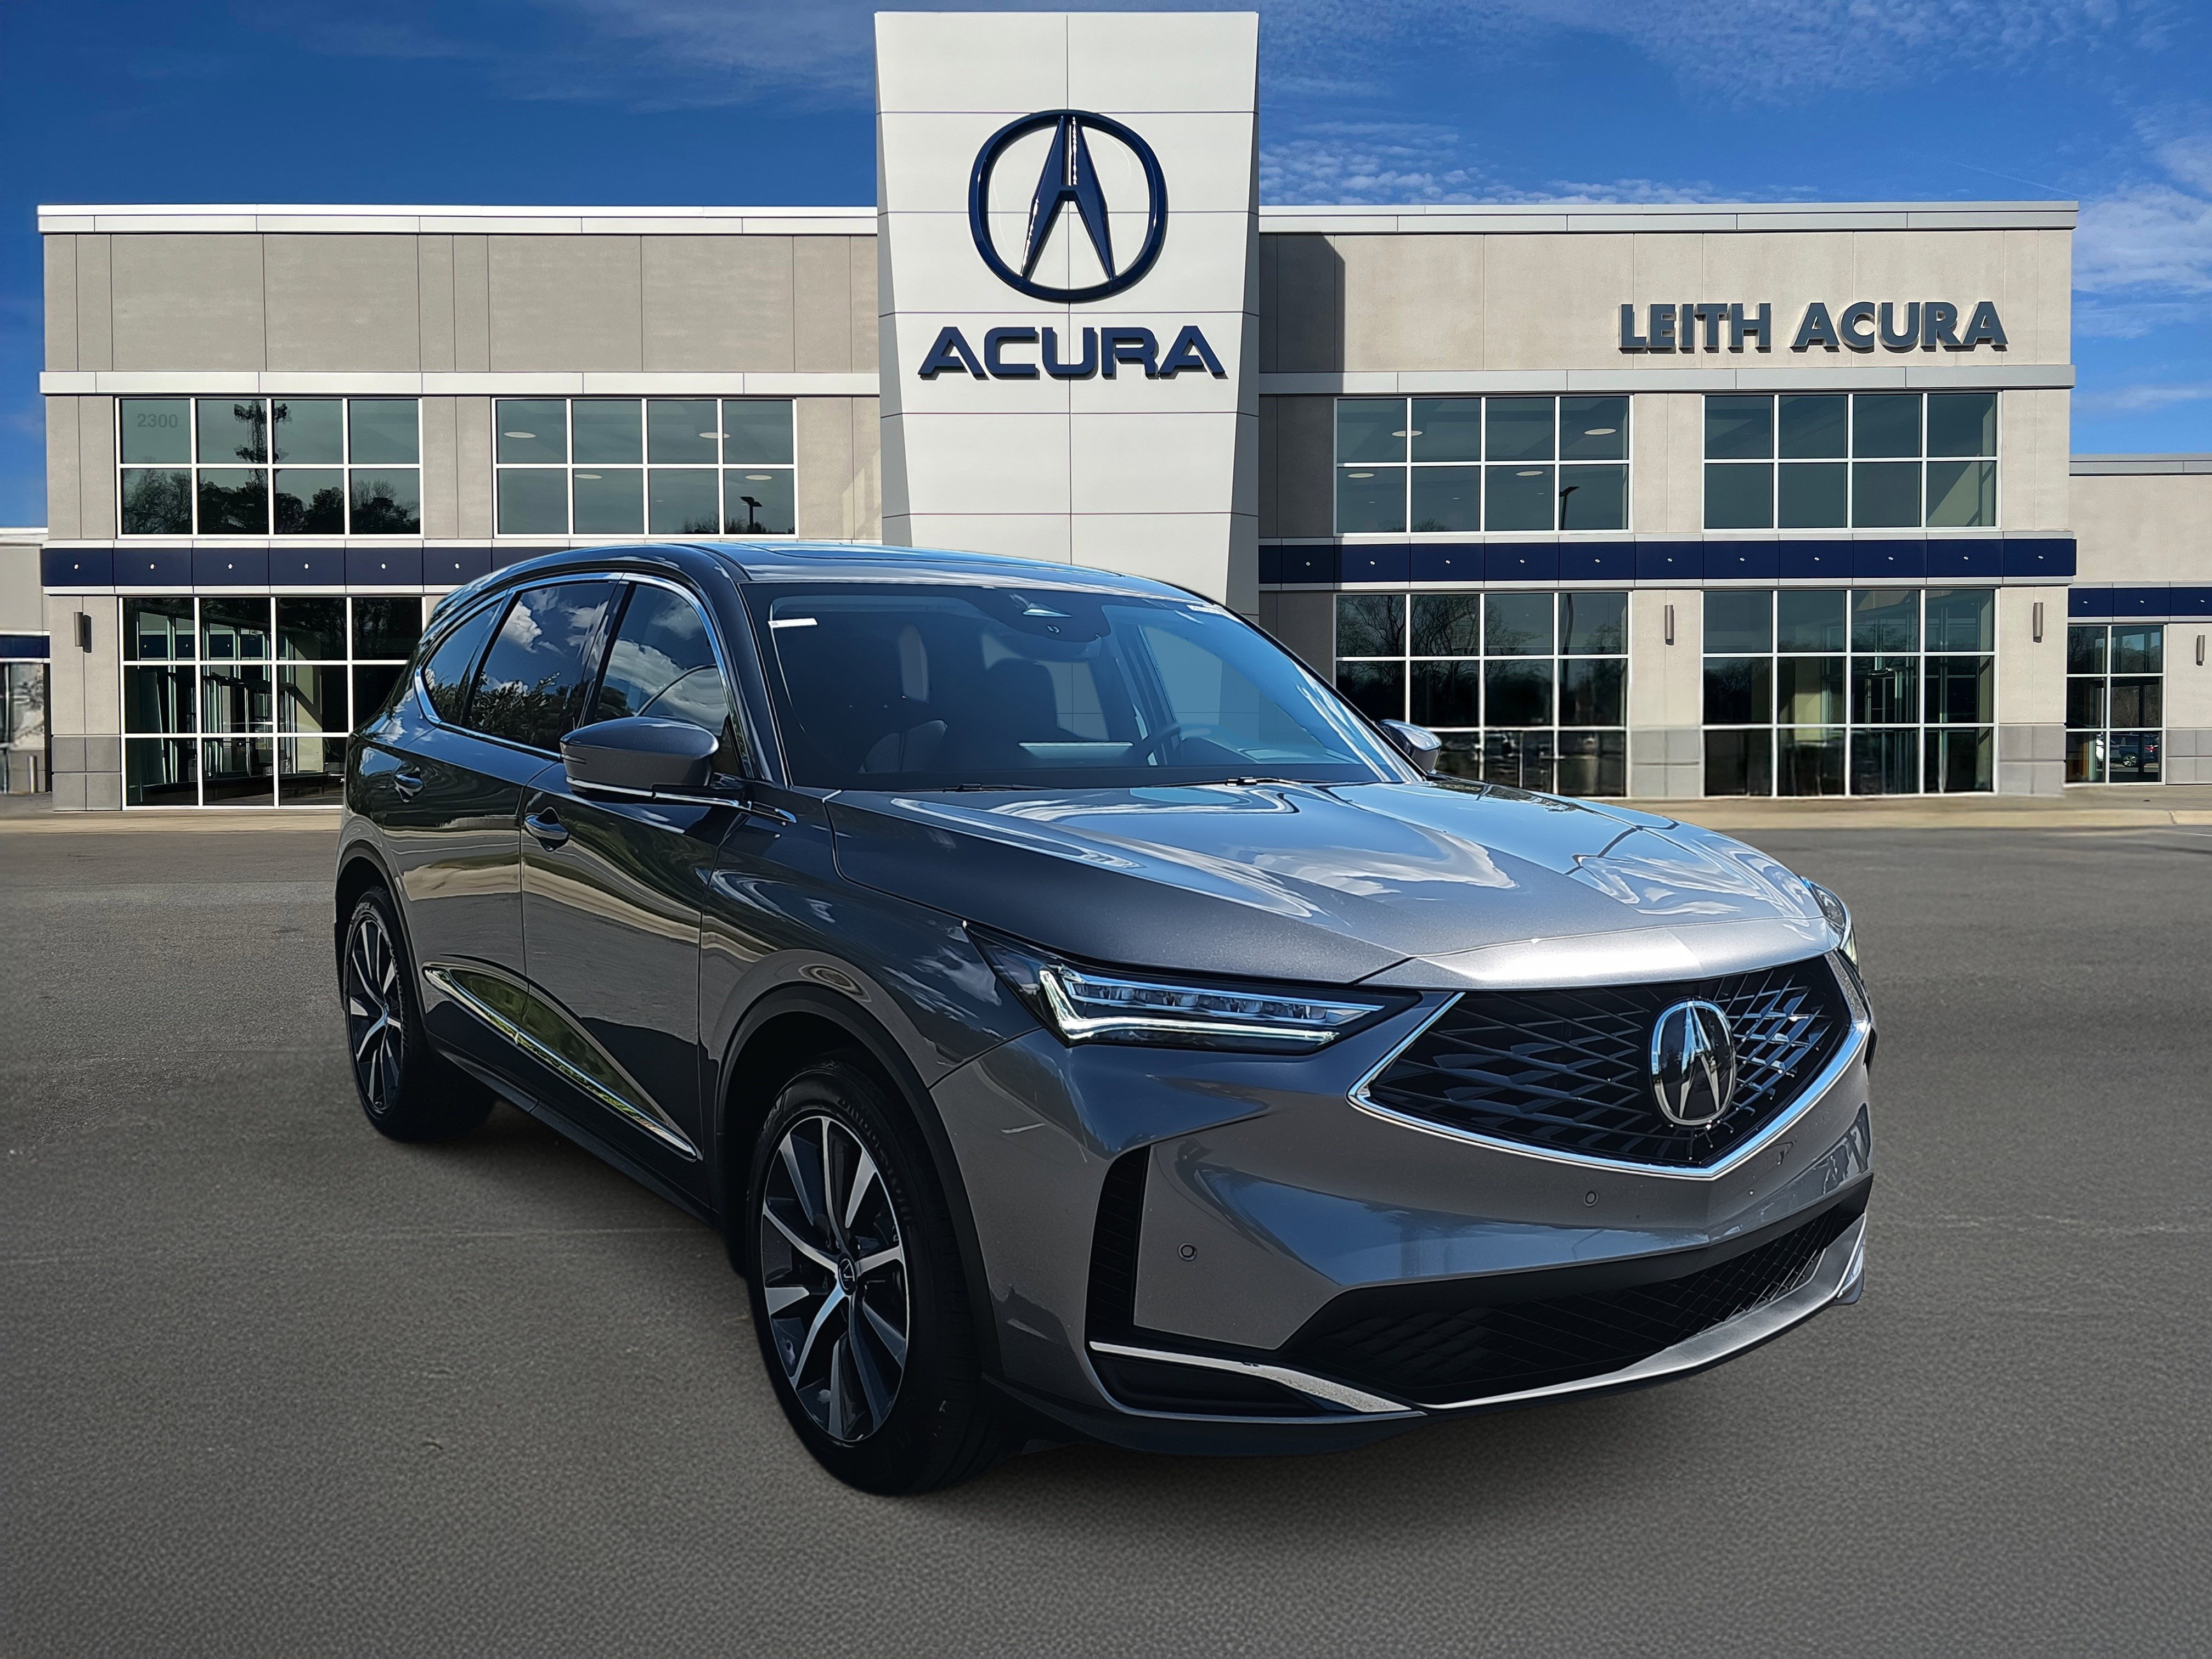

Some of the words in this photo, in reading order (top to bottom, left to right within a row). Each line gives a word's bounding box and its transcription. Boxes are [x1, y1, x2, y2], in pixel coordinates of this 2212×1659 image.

[918, 325, 1227, 380] ACURA
[1618, 303, 1771, 354] LEITH
[1790, 301, 2009, 354] ACURA
[137, 413, 178, 428] 2300
